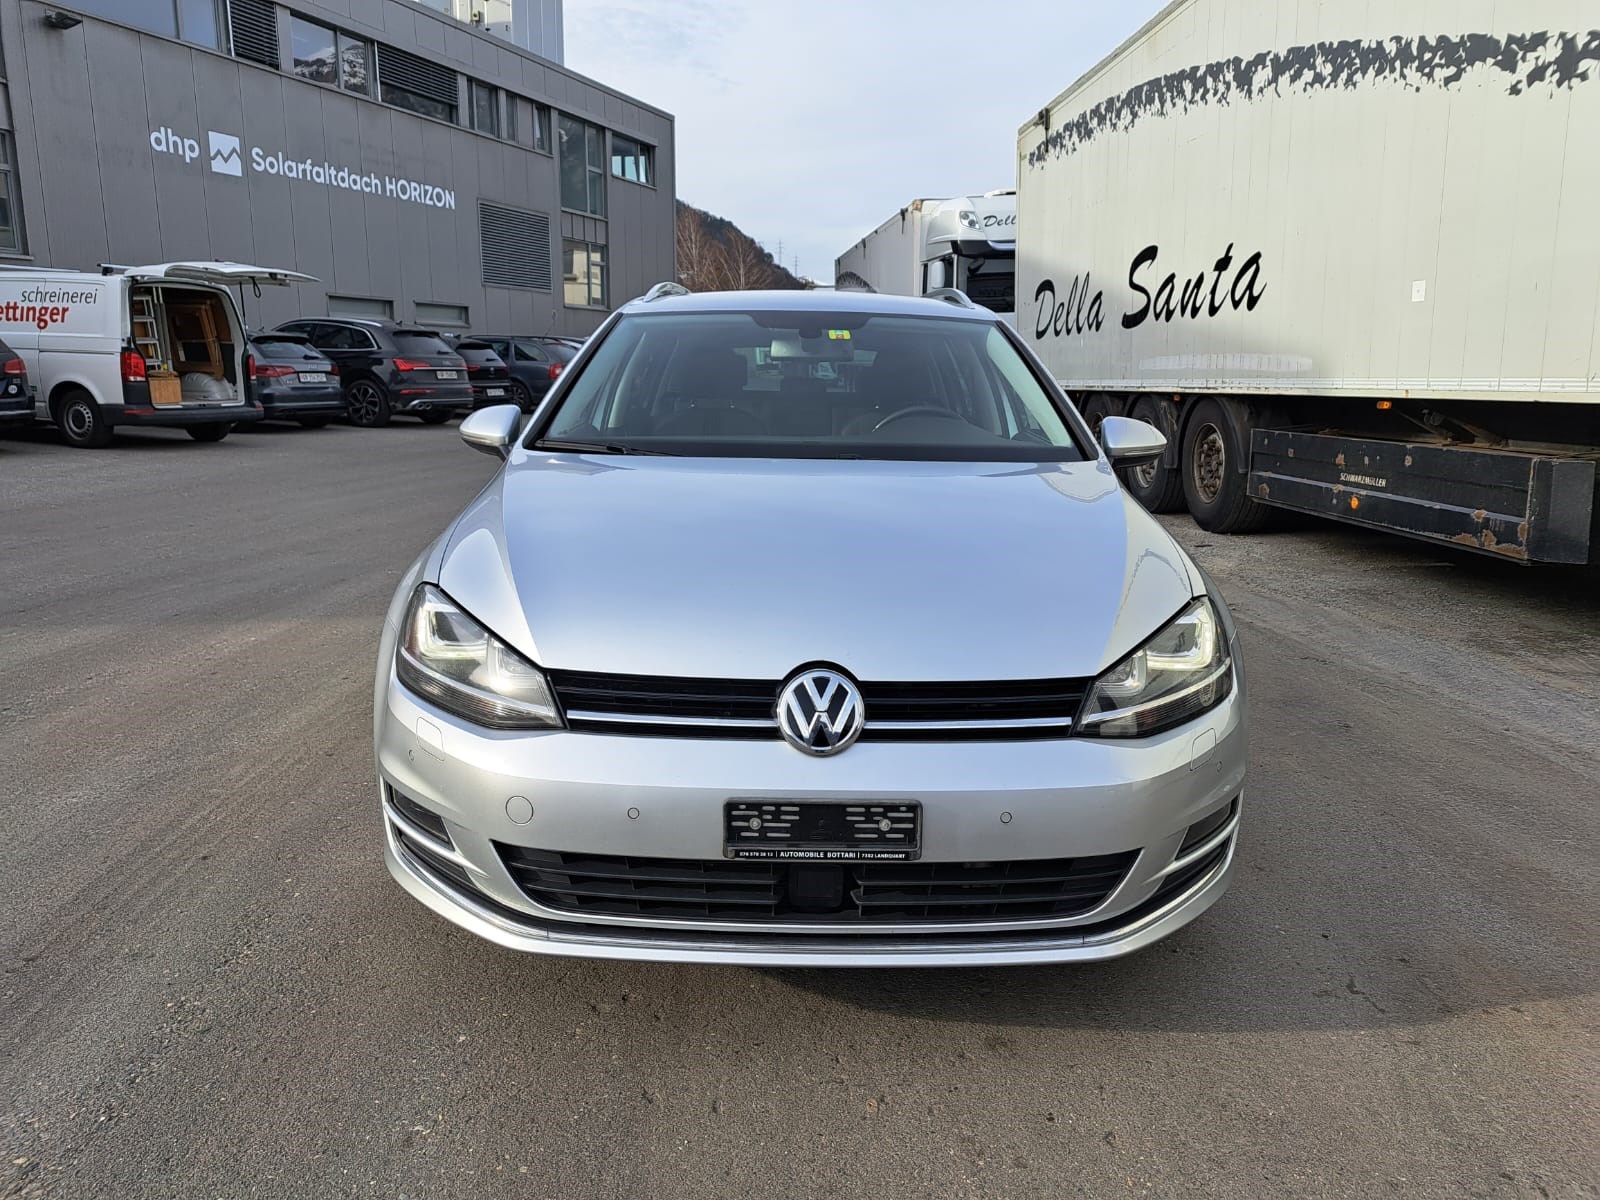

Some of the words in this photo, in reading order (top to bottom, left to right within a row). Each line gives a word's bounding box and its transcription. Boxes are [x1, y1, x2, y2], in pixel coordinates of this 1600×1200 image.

[150, 127, 199, 162] dhp
[251, 147, 382, 195] Solarfaltdach
[385, 176, 456, 210] HORIZON
[21, 286, 98, 304] schreinerei
[1035, 271, 1105, 340] Della
[1121, 242, 1268, 329] Santa
[781, 670, 862, 753] VW
